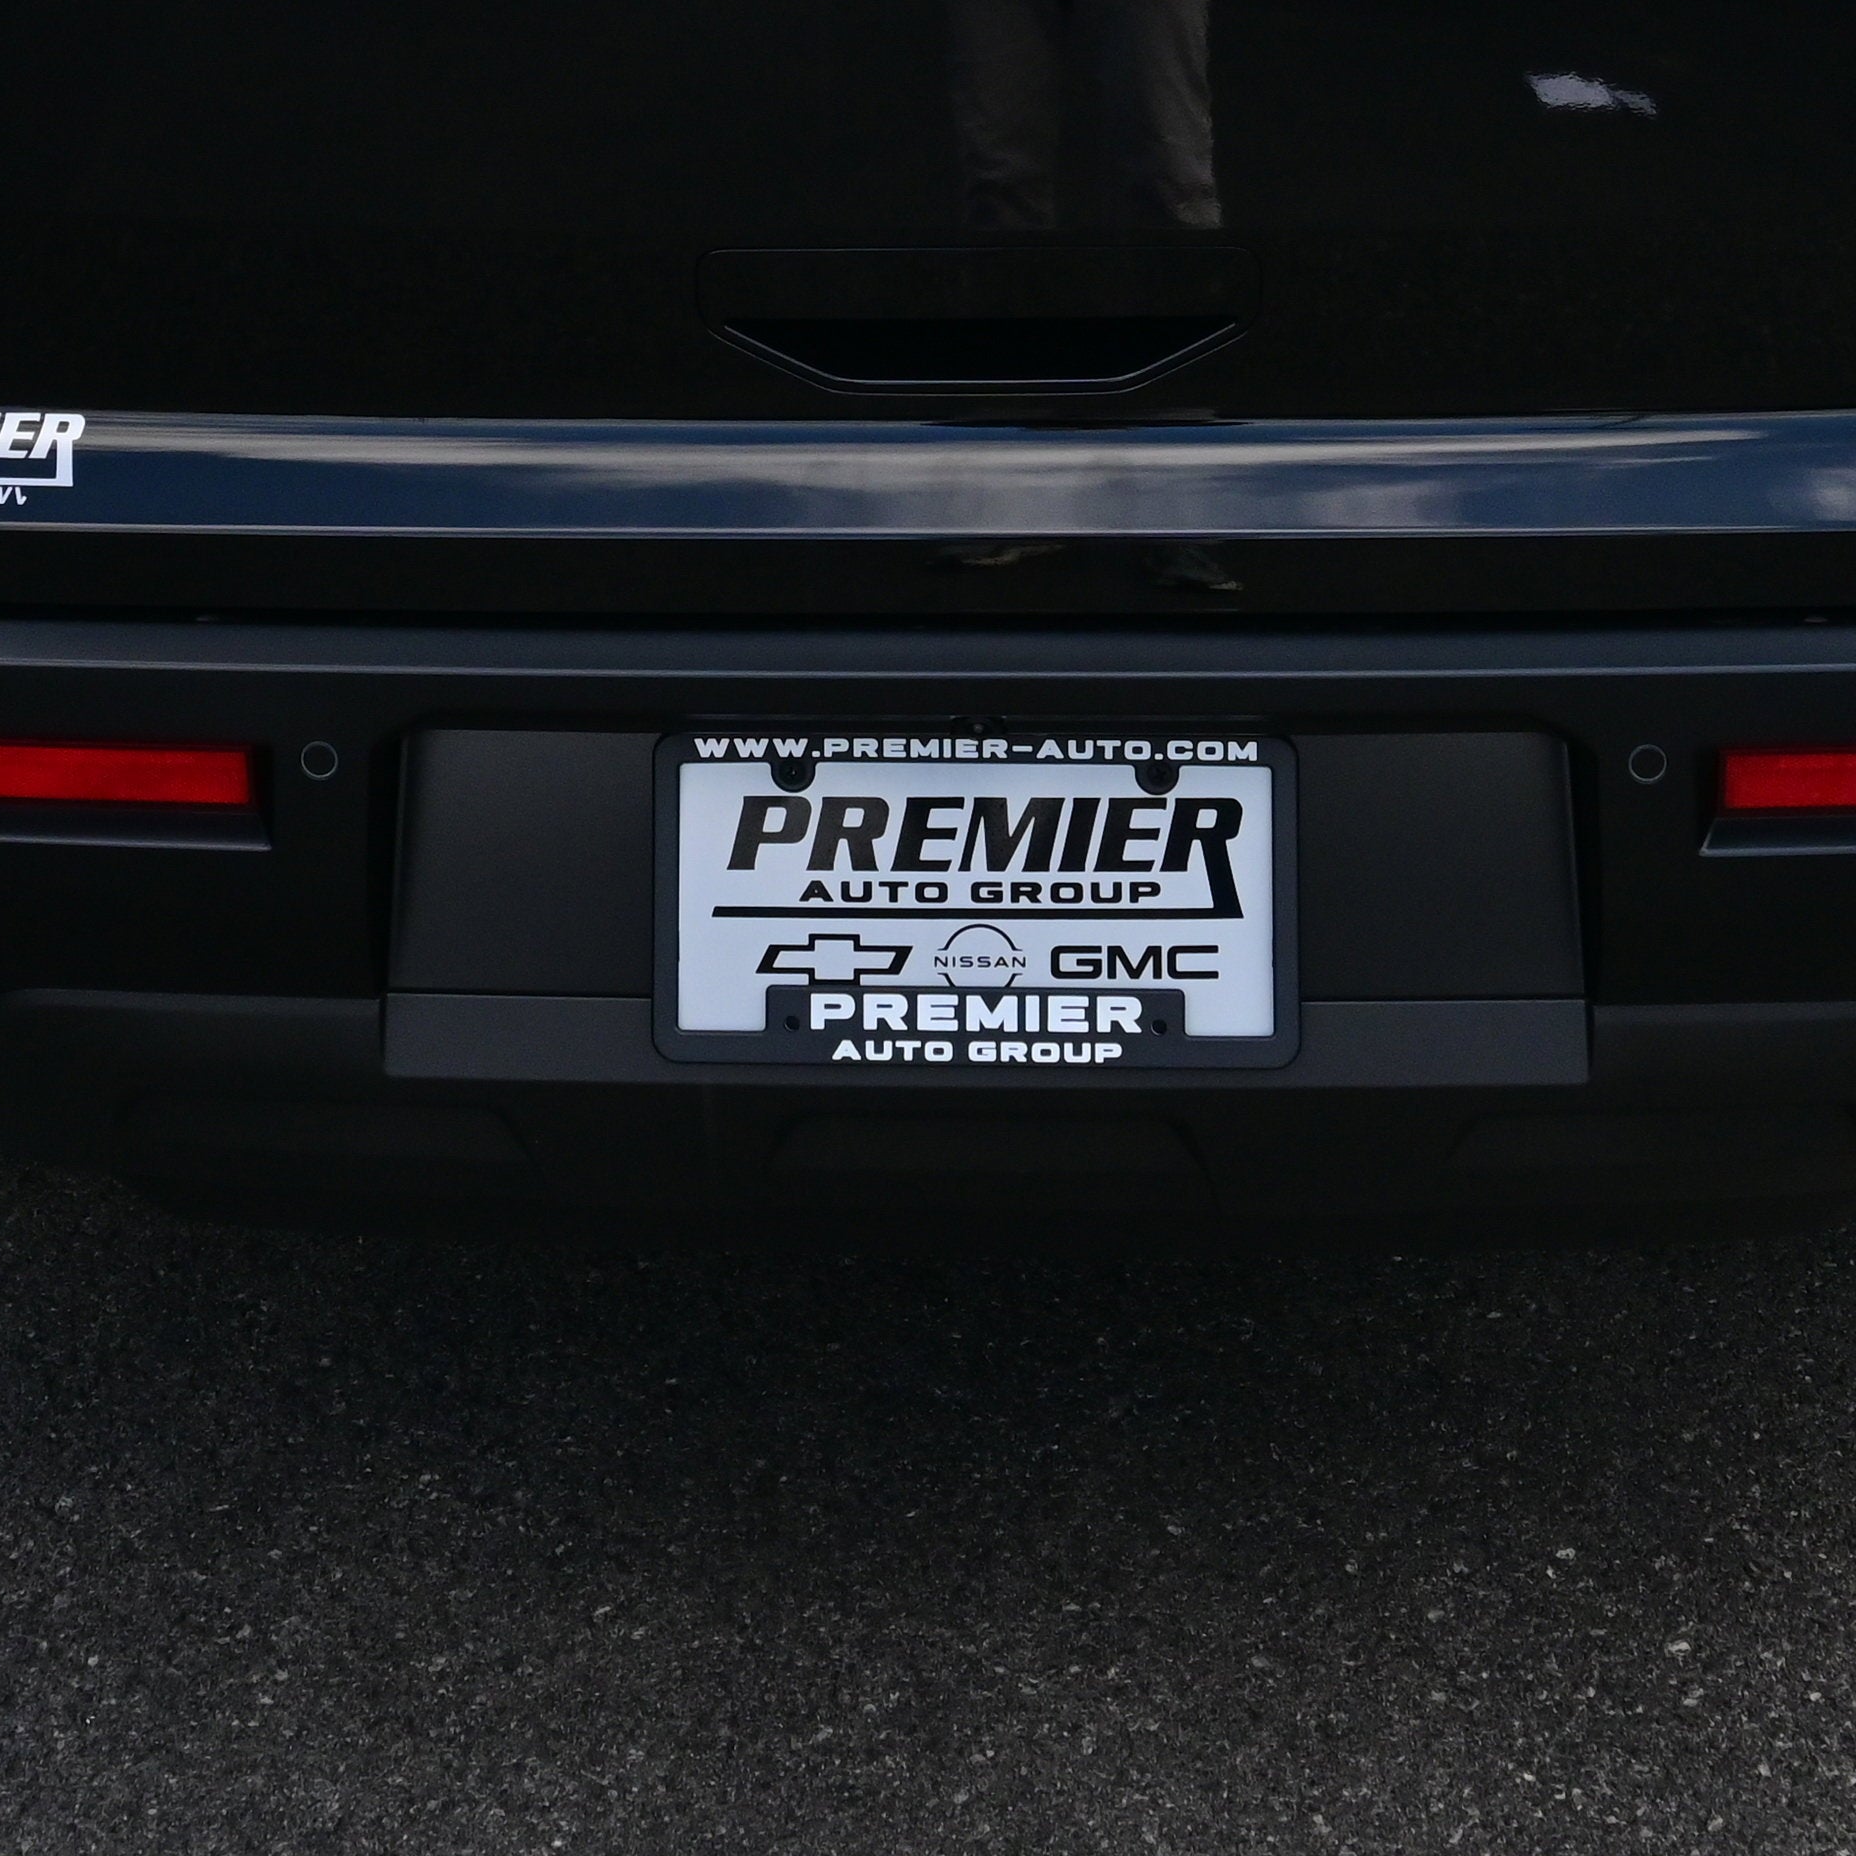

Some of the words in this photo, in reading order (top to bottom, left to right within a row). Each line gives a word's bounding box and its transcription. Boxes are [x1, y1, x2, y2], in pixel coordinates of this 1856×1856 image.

[693, 737, 1260, 762] WWW.PREMIER-AUTO.COM
[725, 795, 1245, 874] PREMIER
[797, 879, 950, 905] AUTO
[969, 879, 1163, 905] GROUP
[933, 954, 1028, 970] NISSAN
[1049, 944, 1221, 981] GMC
[809, 992, 1144, 1035] PREMIER
[831, 1038, 955, 1062] AUTO
[967, 1039, 1124, 1065] GROUP
